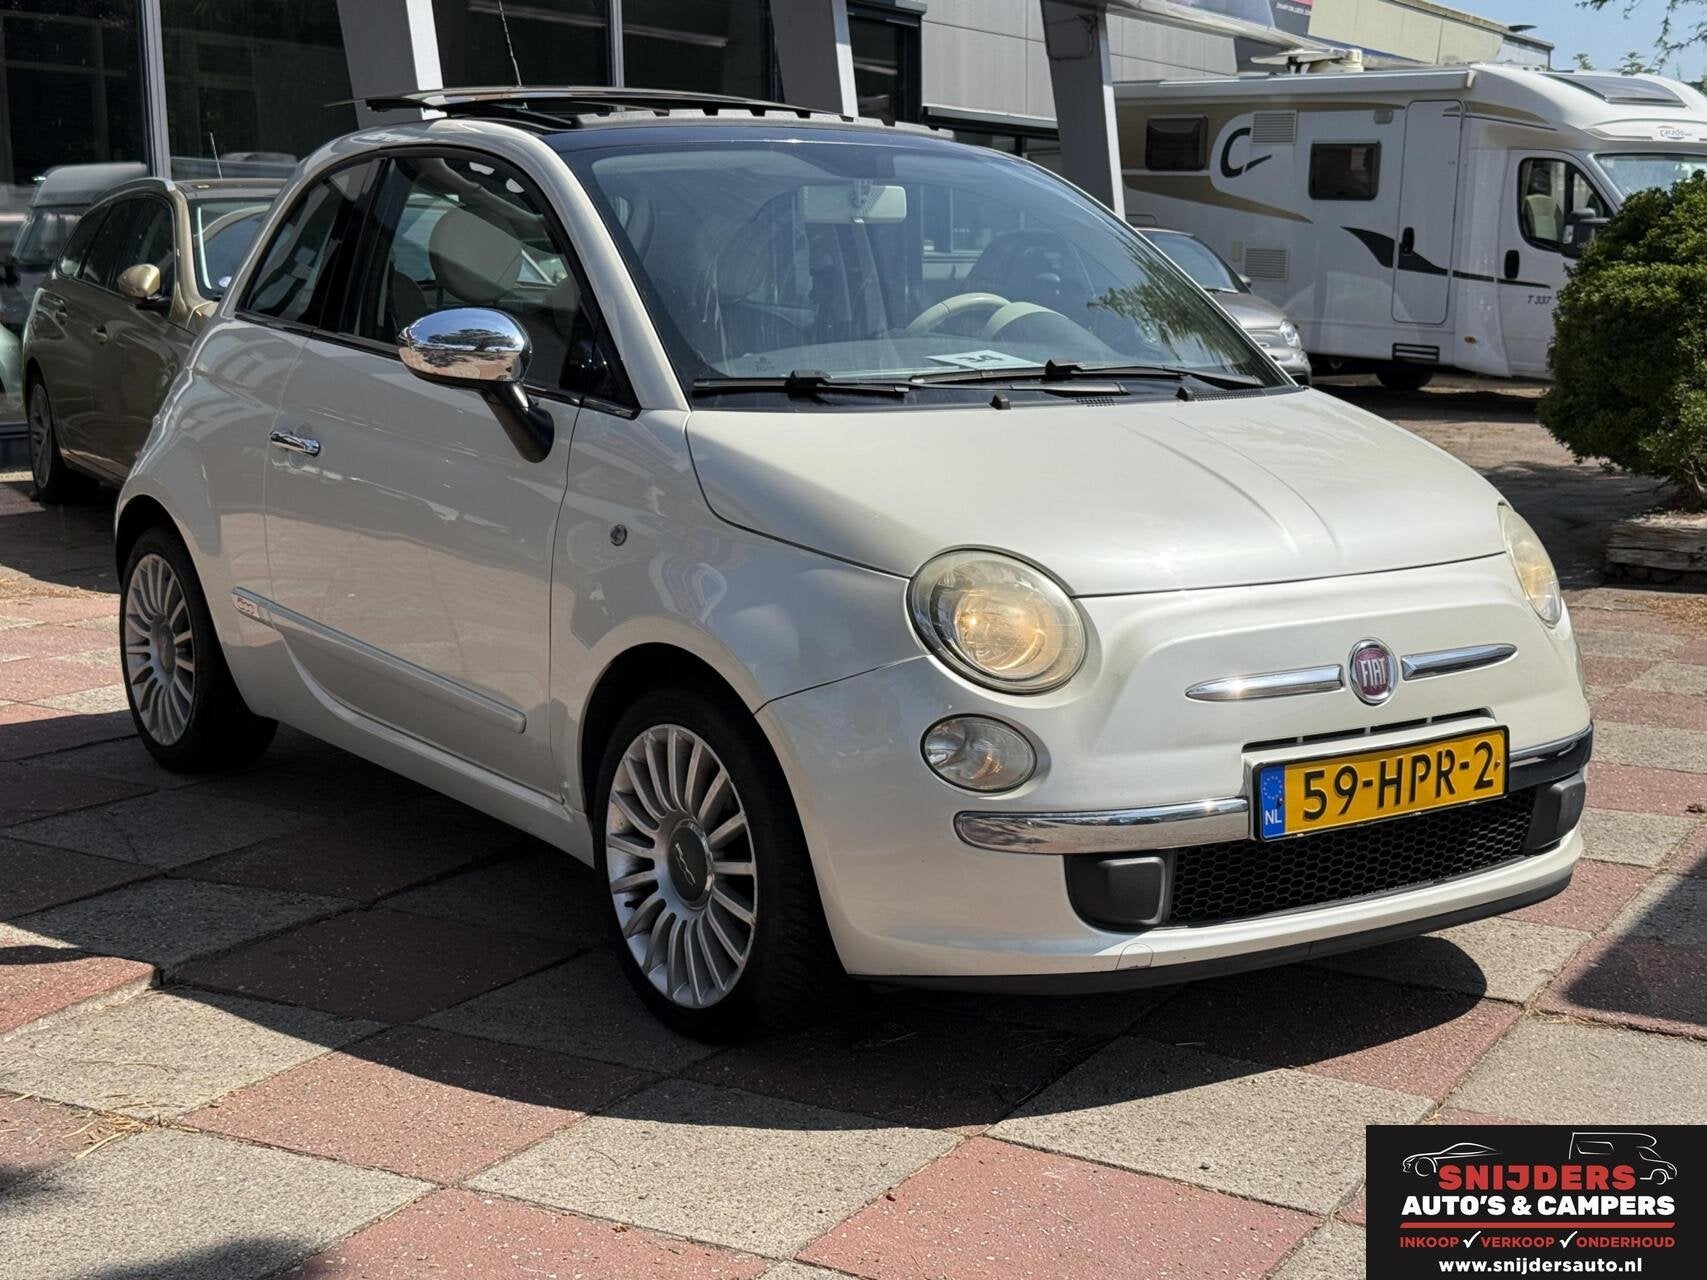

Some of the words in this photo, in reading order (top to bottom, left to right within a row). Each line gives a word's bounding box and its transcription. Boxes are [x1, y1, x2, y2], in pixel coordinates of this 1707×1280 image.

[1527, 294, 1535, 304] T
[1534, 295, 1552, 305] 337
[1358, 657, 1387, 688] FIAT
[1303, 741, 1495, 822] 59-HPR-2
[1264, 808, 1283, 826] NL
